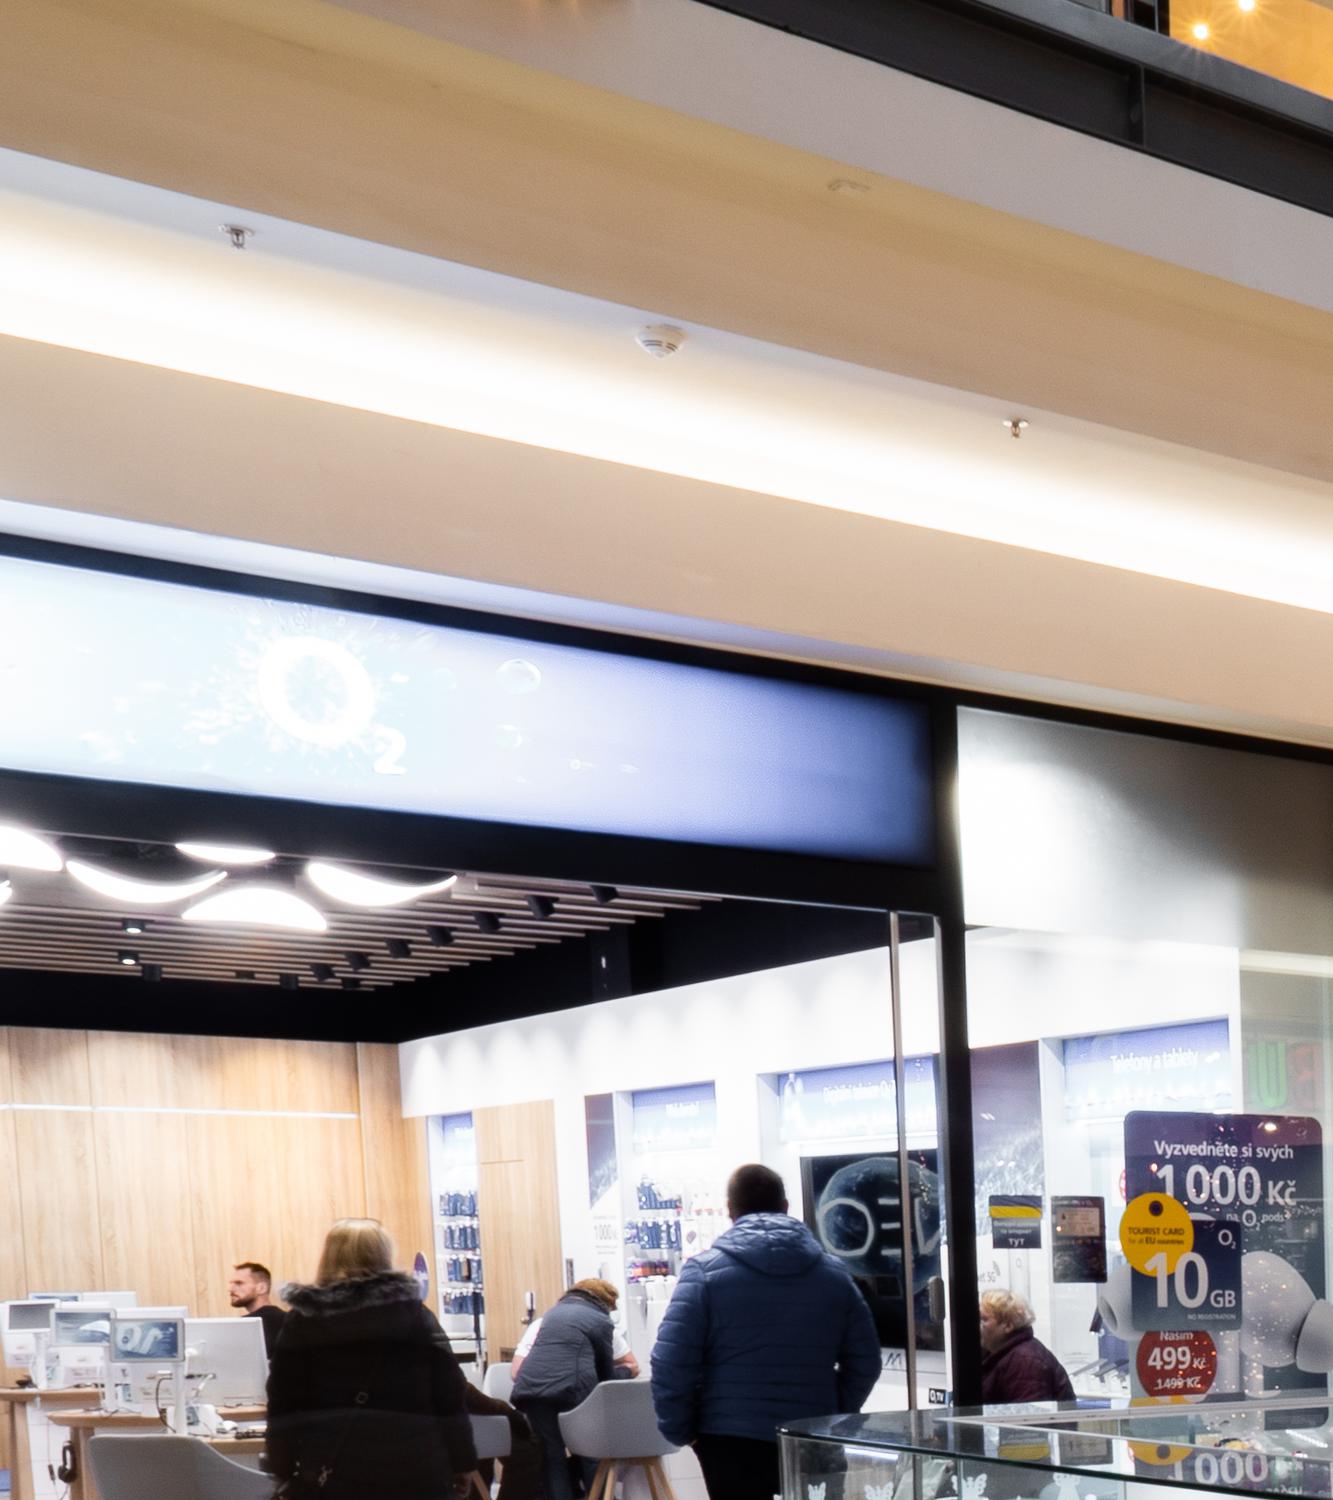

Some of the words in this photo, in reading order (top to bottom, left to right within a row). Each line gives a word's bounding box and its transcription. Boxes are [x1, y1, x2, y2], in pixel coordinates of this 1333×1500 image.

[1154, 1140, 1238, 1160] Vyzvedněte
[1241, 1143, 1253, 1156] si
[1256, 1144, 1294, 1162] svých
[1267, 1180, 1297, 1206] Kč
[1128, 1227, 1161, 1236] TOURIST
[1163, 1226, 1185, 1236] CARD
[1143, 1251, 1209, 1309] 10
[1210, 1289, 1236, 1308] GB
[1147, 1345, 1191, 1371] 499
